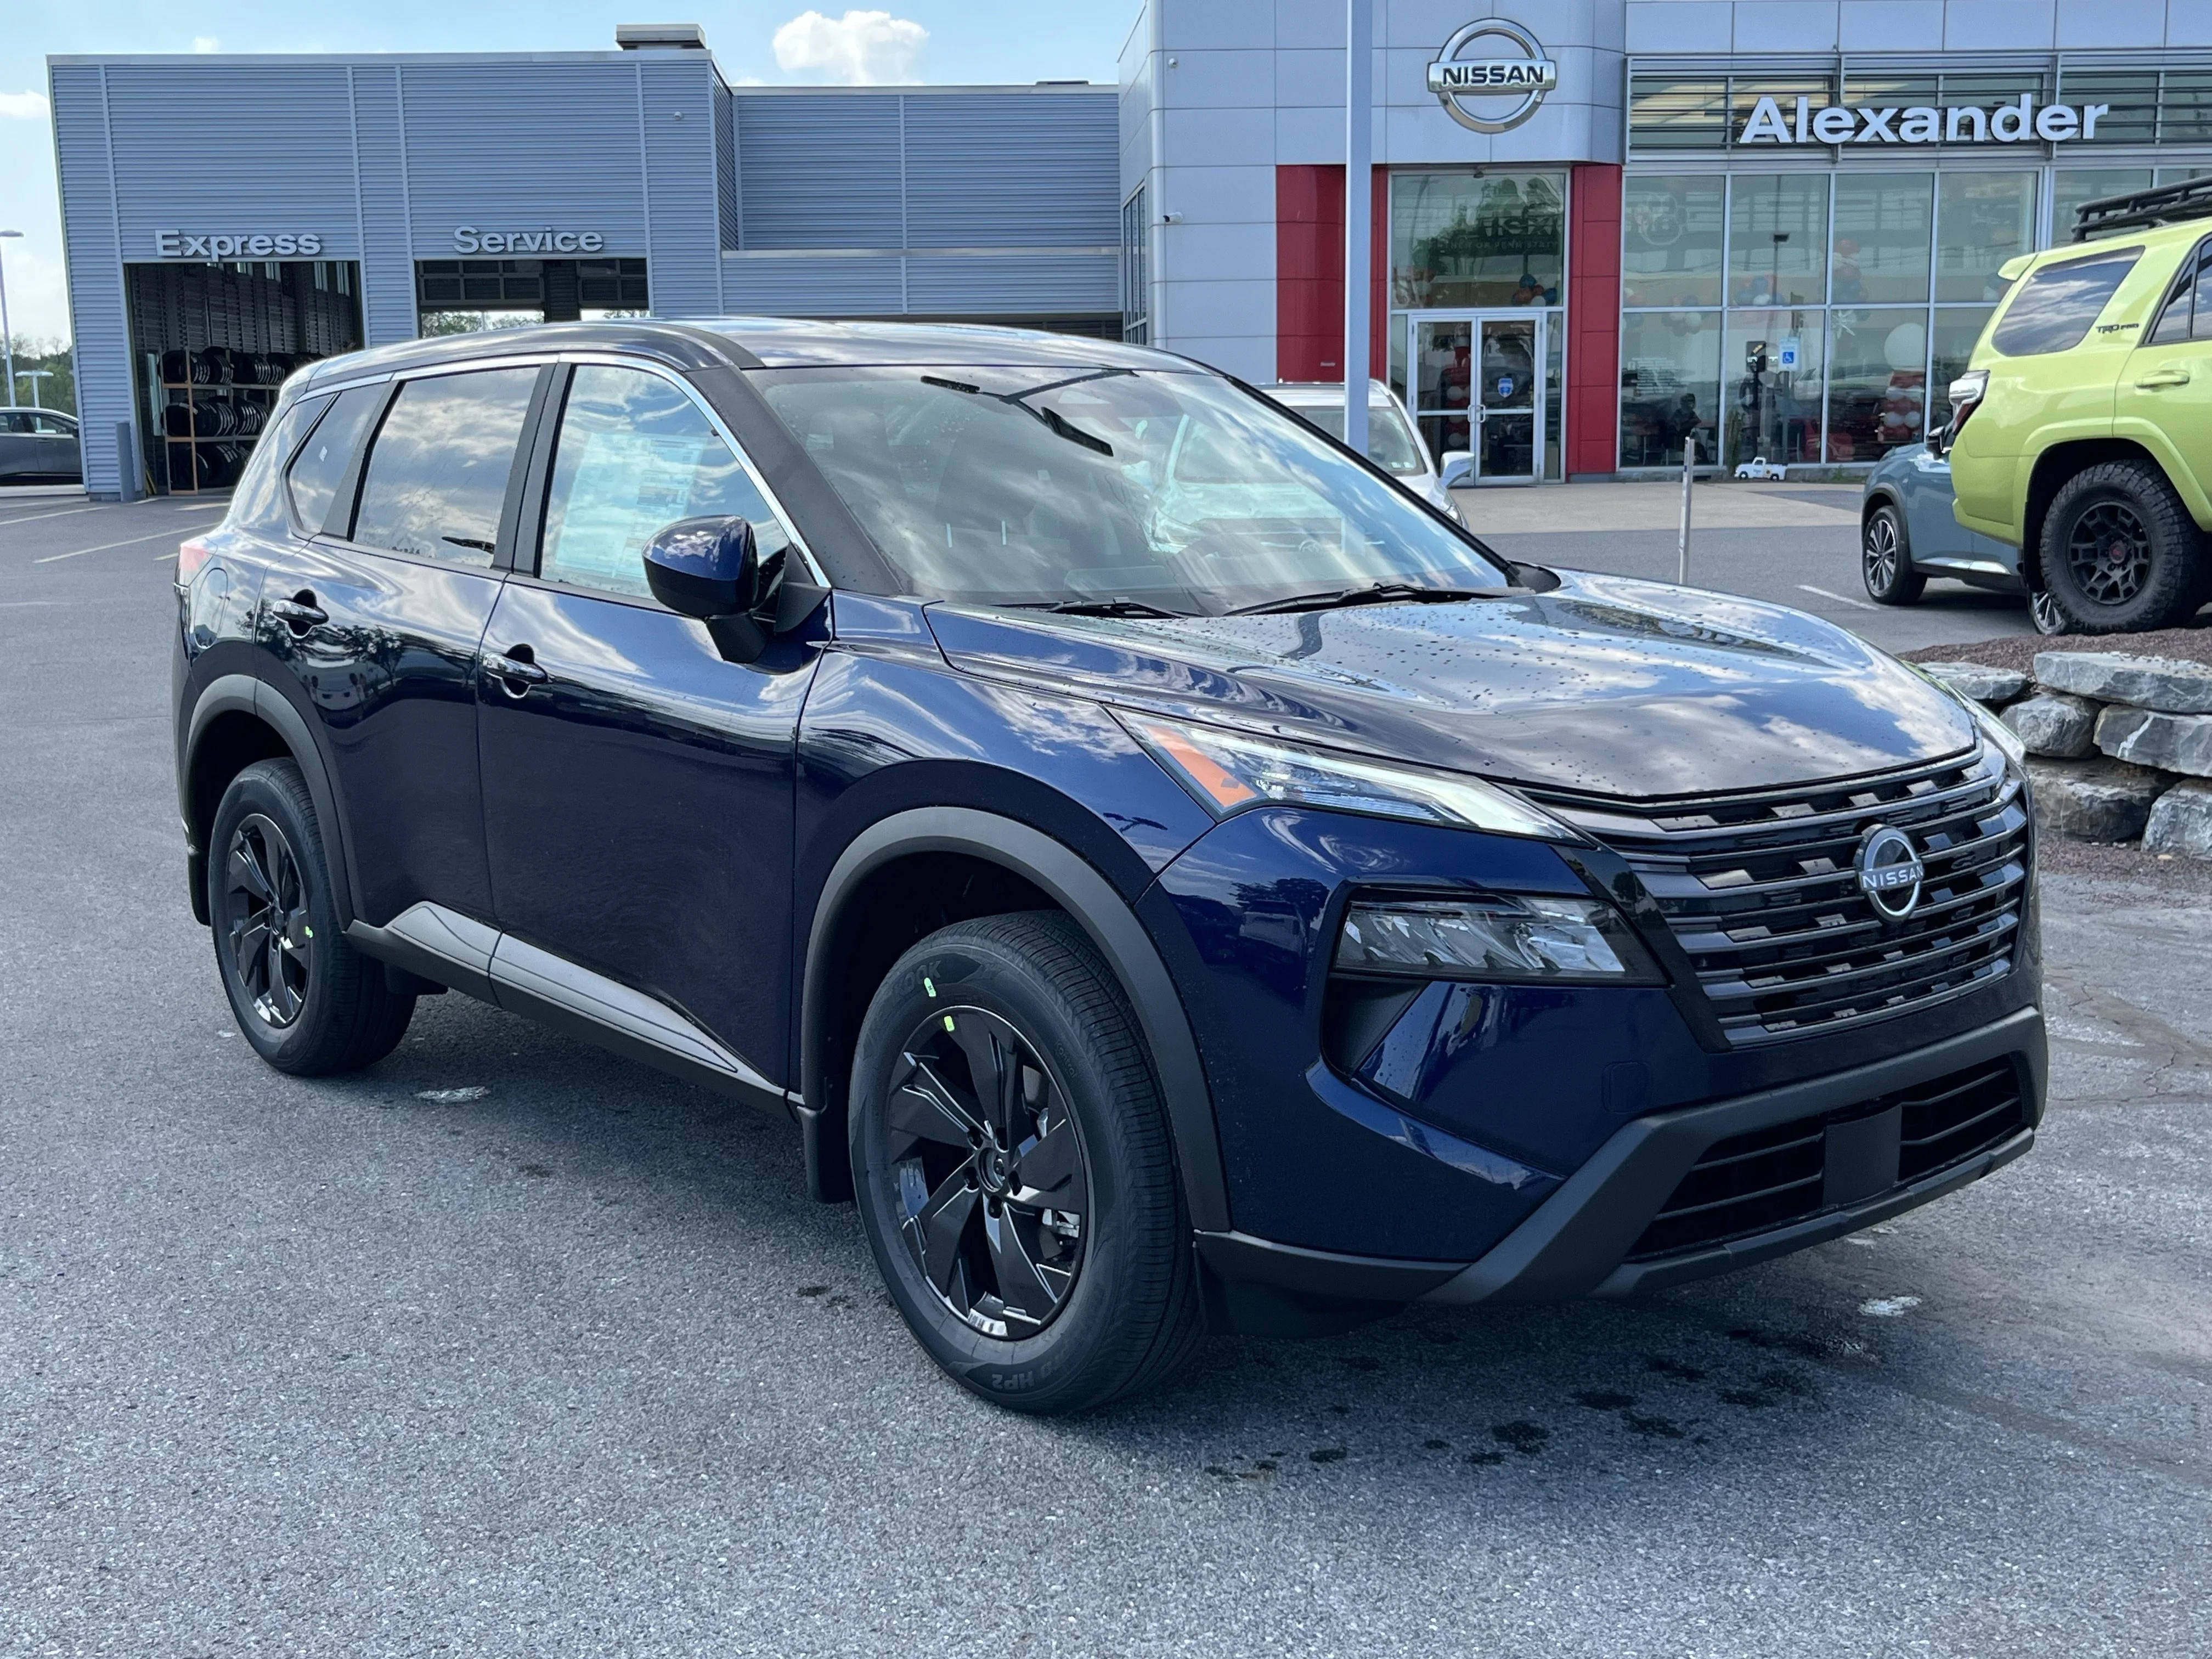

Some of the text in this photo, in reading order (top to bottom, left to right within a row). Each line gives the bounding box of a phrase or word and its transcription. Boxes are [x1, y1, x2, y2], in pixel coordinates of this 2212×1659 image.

[1442, 65, 1544, 84] NISSAN
[1739, 93, 2109, 144] Alexander
[155, 229, 321, 262] Express
[453, 226, 603, 253] Service
[2096, 324, 2119, 334] TRD
[1863, 865, 1923, 888] NISSAN
[991, 1371, 1035, 1390] HP2
